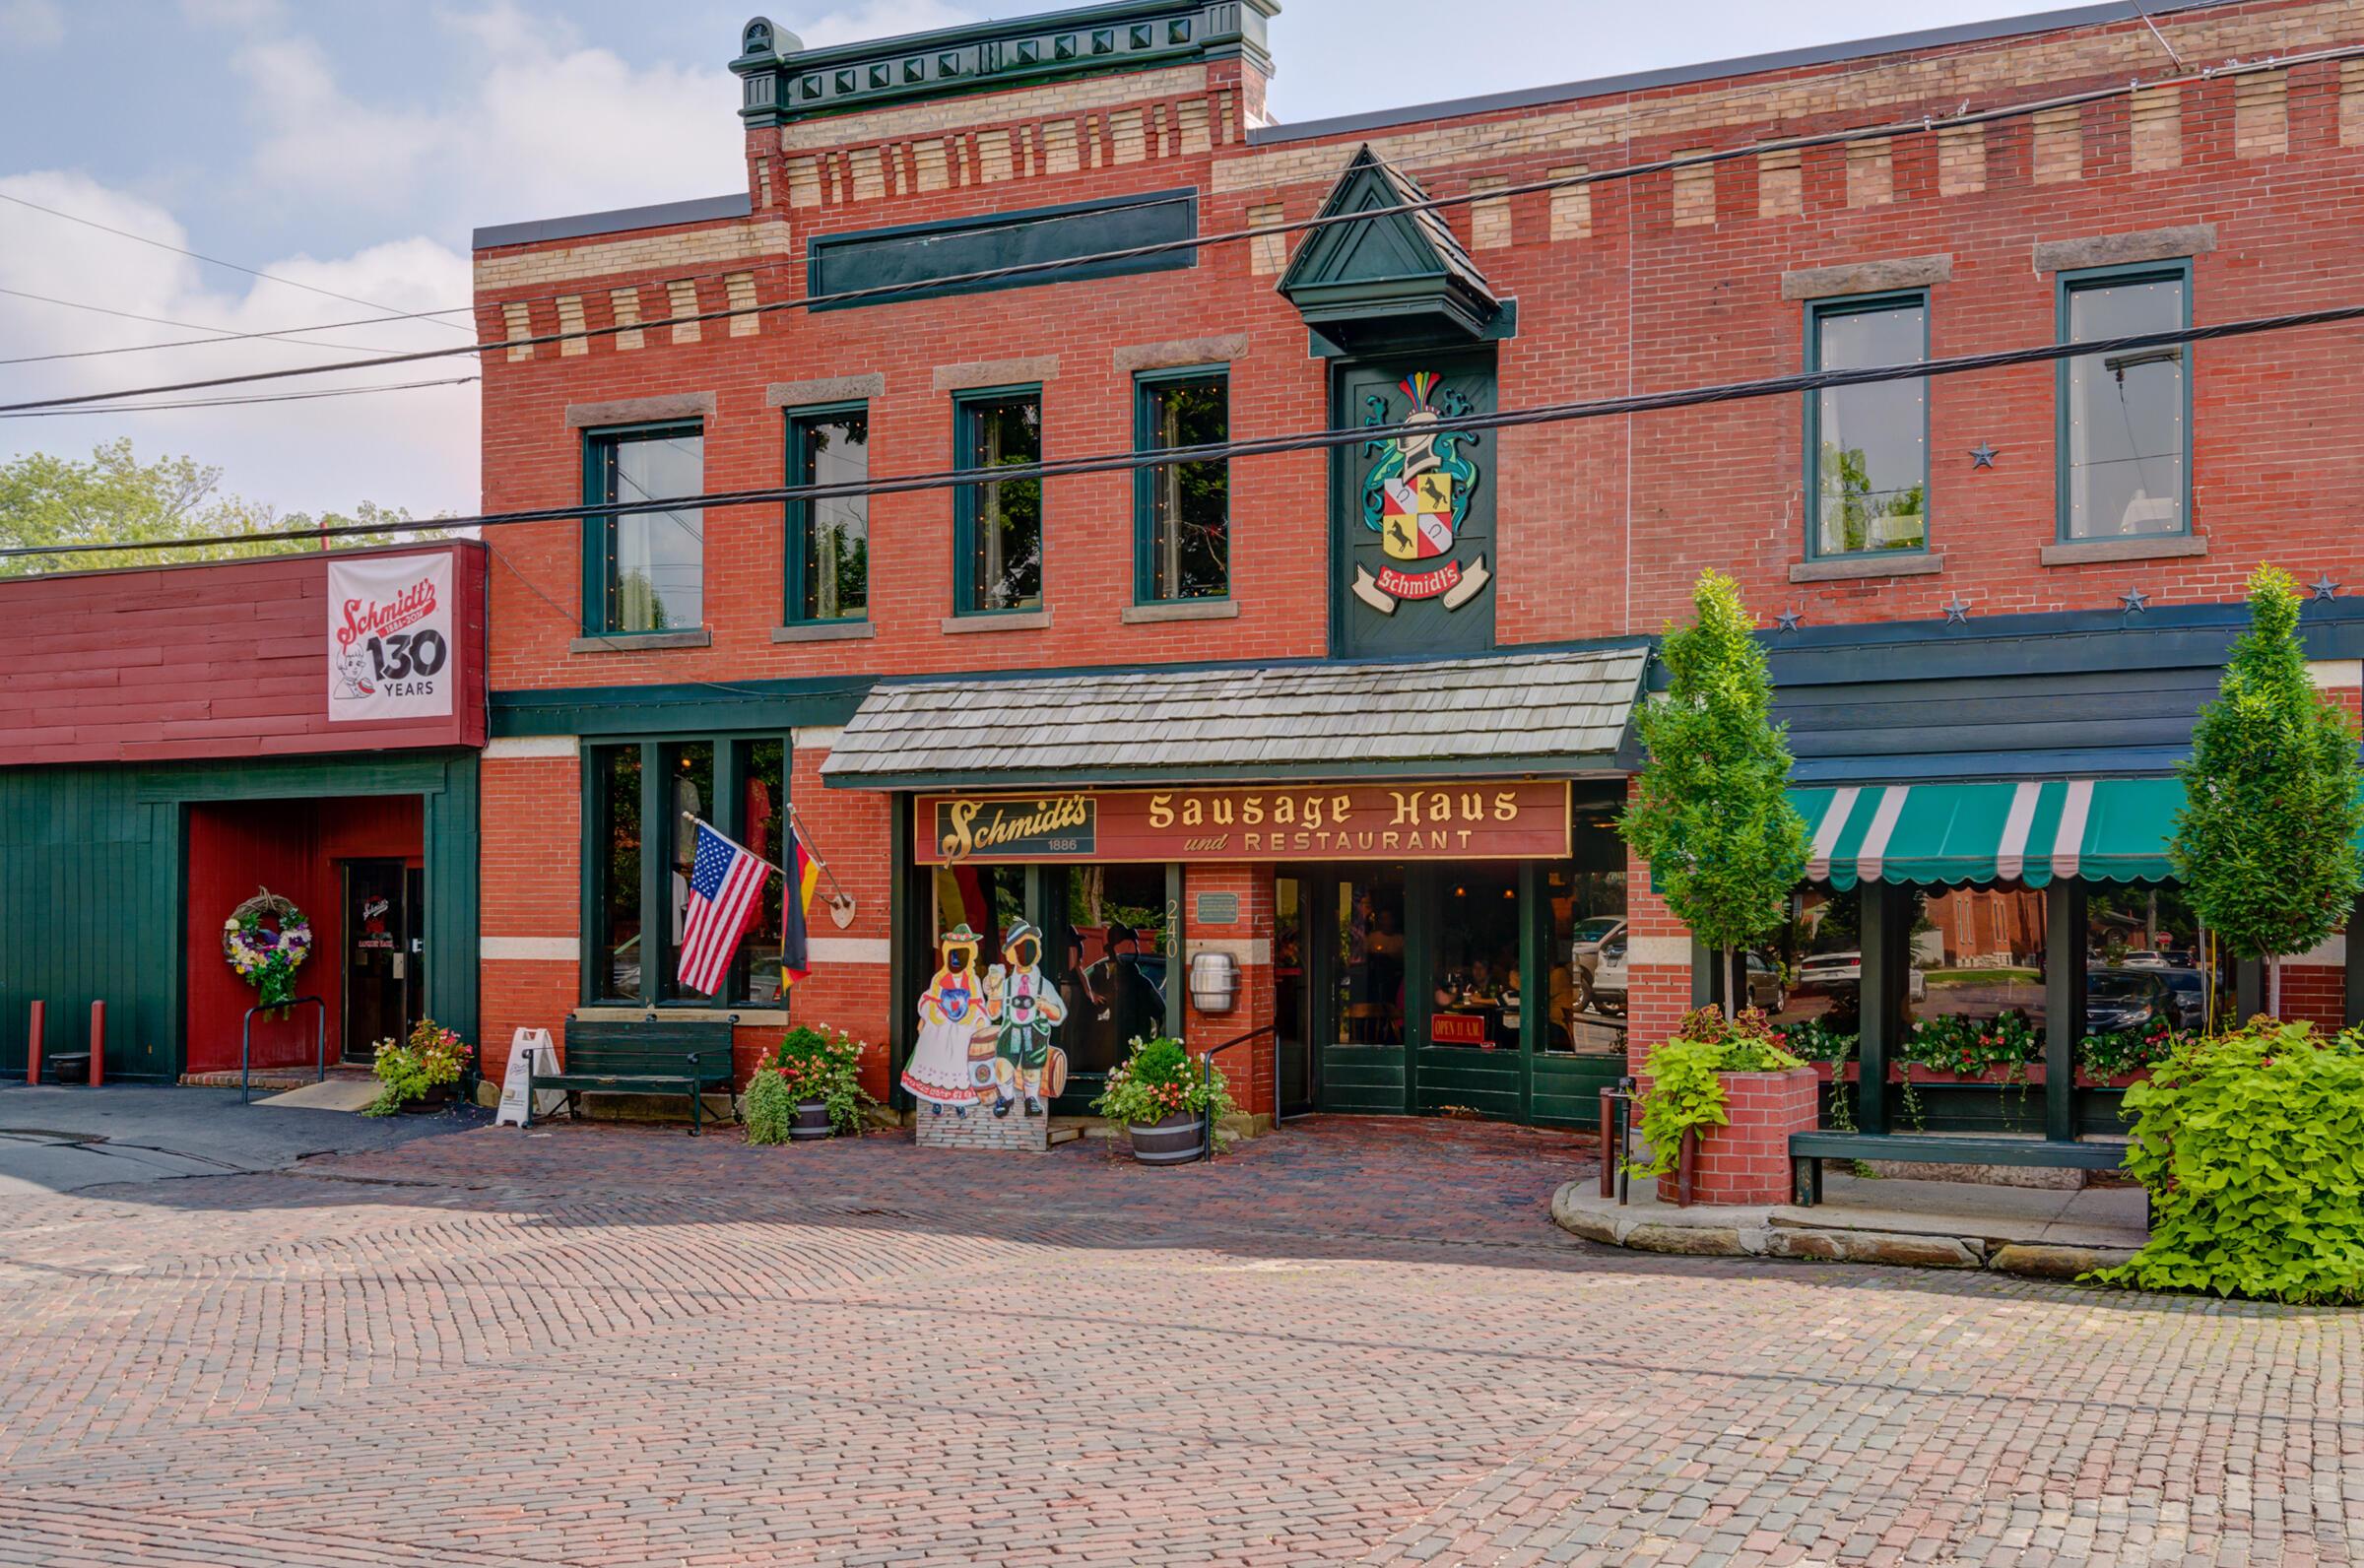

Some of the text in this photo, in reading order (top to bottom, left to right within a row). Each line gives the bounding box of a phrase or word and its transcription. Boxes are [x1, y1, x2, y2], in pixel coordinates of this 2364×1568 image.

[1379, 567, 1458, 594] Schmidt's
[337, 578, 435, 655] Schmidt's
[366, 629, 446, 682] 130
[384, 682, 433, 696] YEARS
[1149, 791, 1519, 829] Sausage Haus
[942, 795, 1086, 869] Schmidt's
[1047, 839, 1078, 852] 1886
[1183, 830, 1473, 852] und RESTAURANT
[1166, 899, 1178, 959] 240
[1434, 1020, 1455, 1036] OPEN
